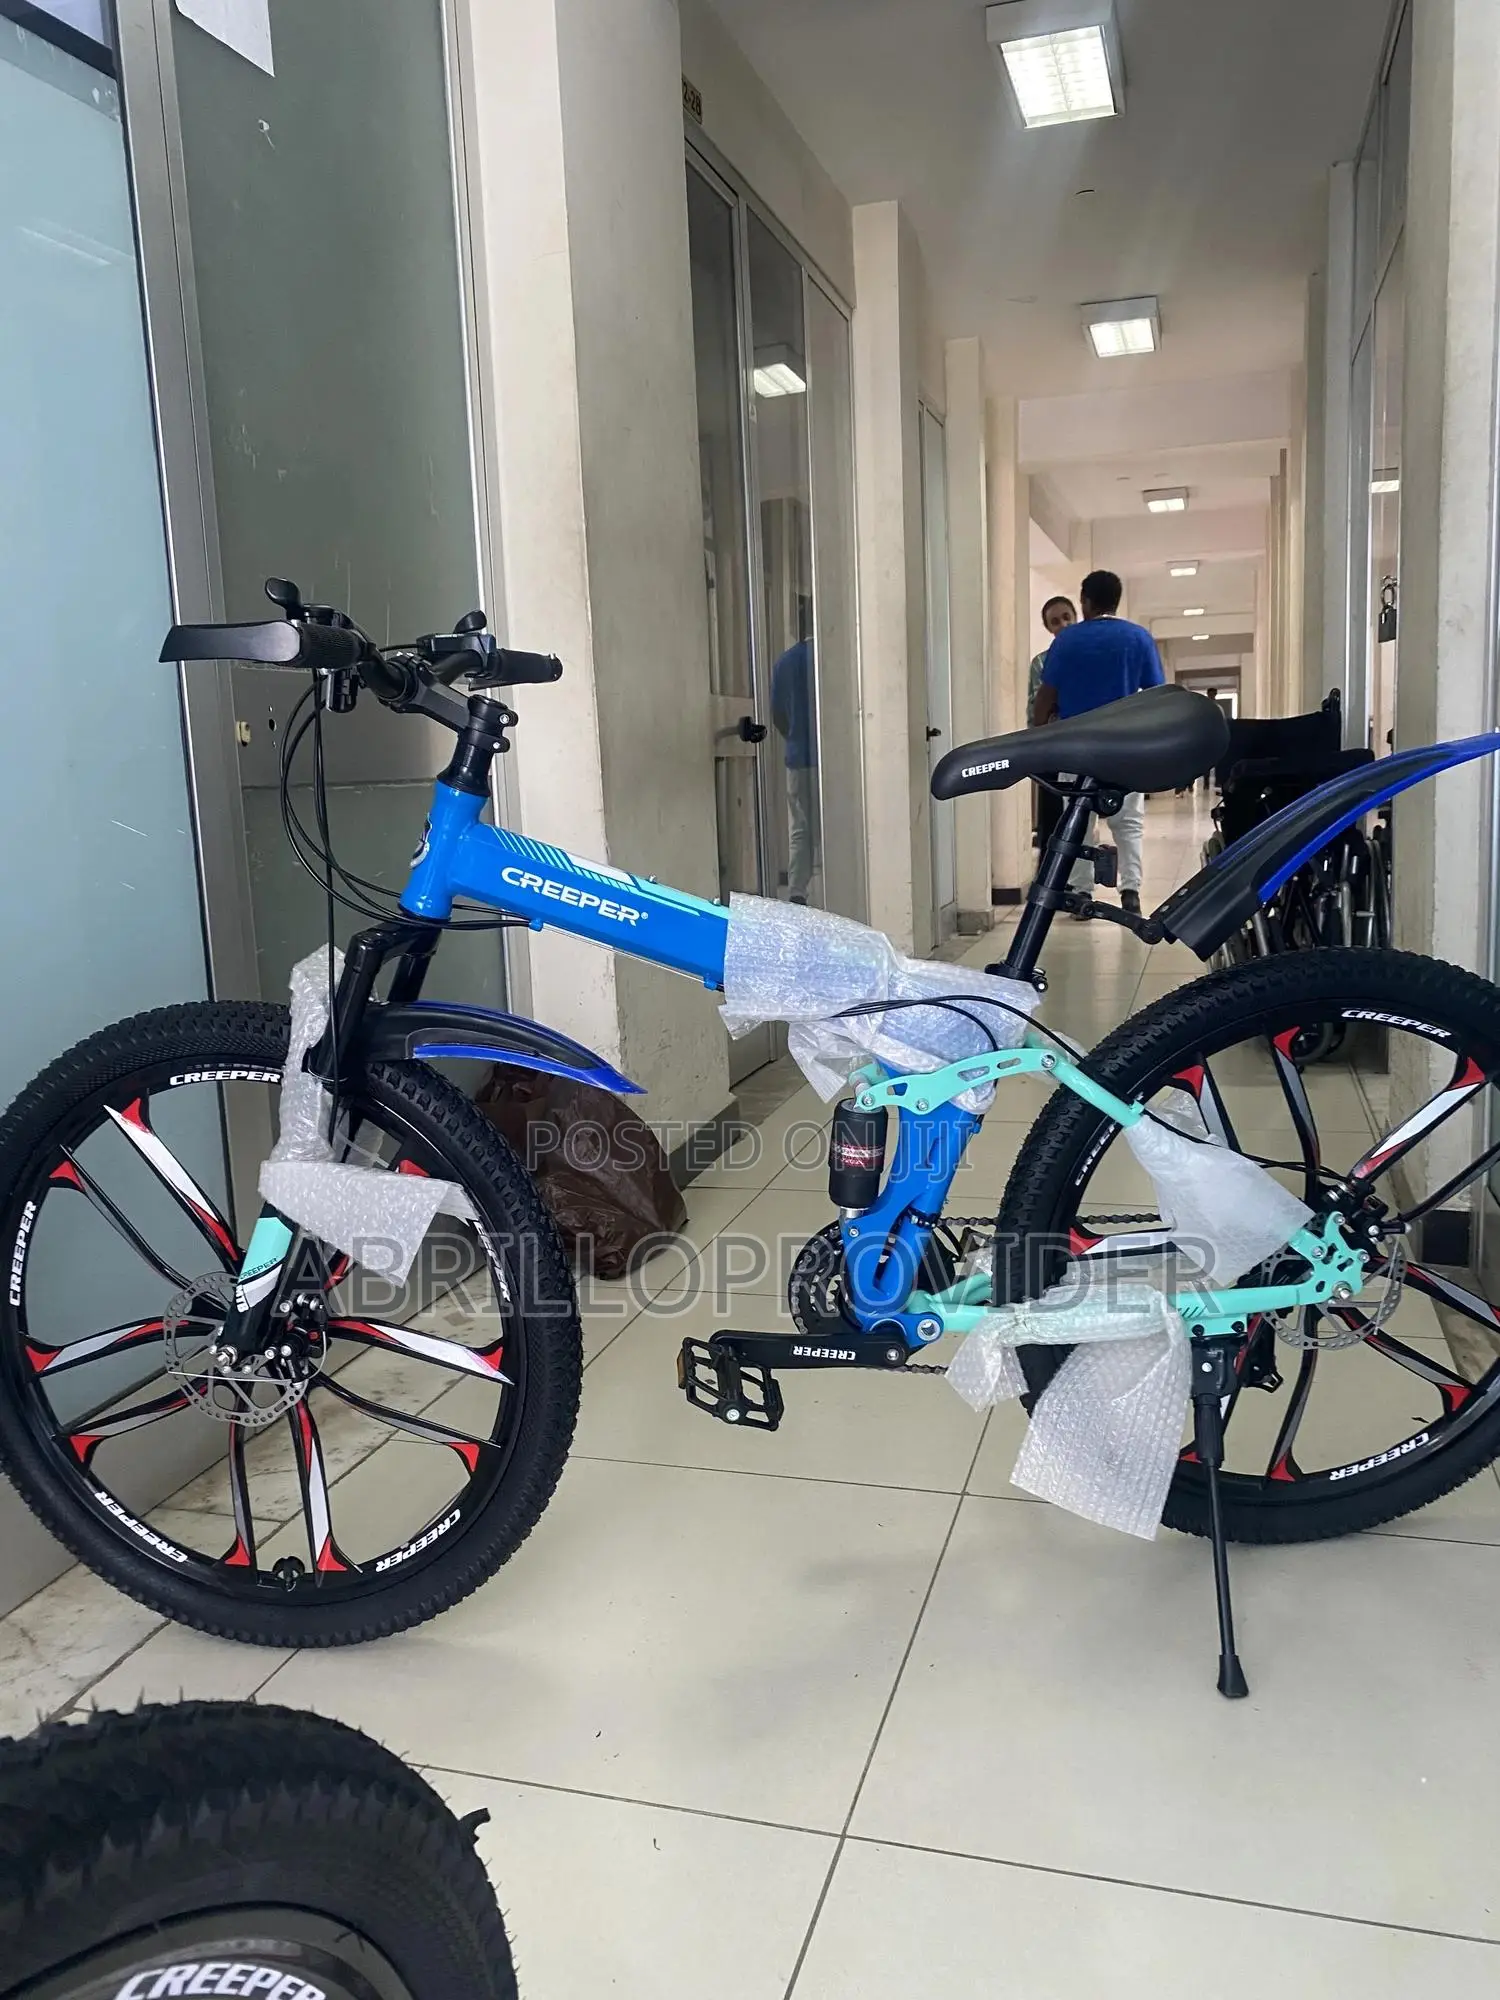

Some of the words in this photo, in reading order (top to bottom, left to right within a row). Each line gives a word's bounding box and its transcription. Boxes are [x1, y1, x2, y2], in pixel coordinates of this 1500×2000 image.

[961, 759, 1010, 778] CREEPER
[1341, 1009, 1452, 1038] CREEPER
[169, 1070, 281, 1086] CREEPER
[8, 1200, 37, 1307] CREEPER
[473, 1221, 511, 1302] EEPER
[235, 1284, 250, 1313] MTB
[793, 1345, 856, 1361] CREEPER
[1329, 1432, 1430, 1481] CREEPER
[94, 1491, 188, 1563] CREEPER
[375, 1508, 461, 1573] CREEPER
